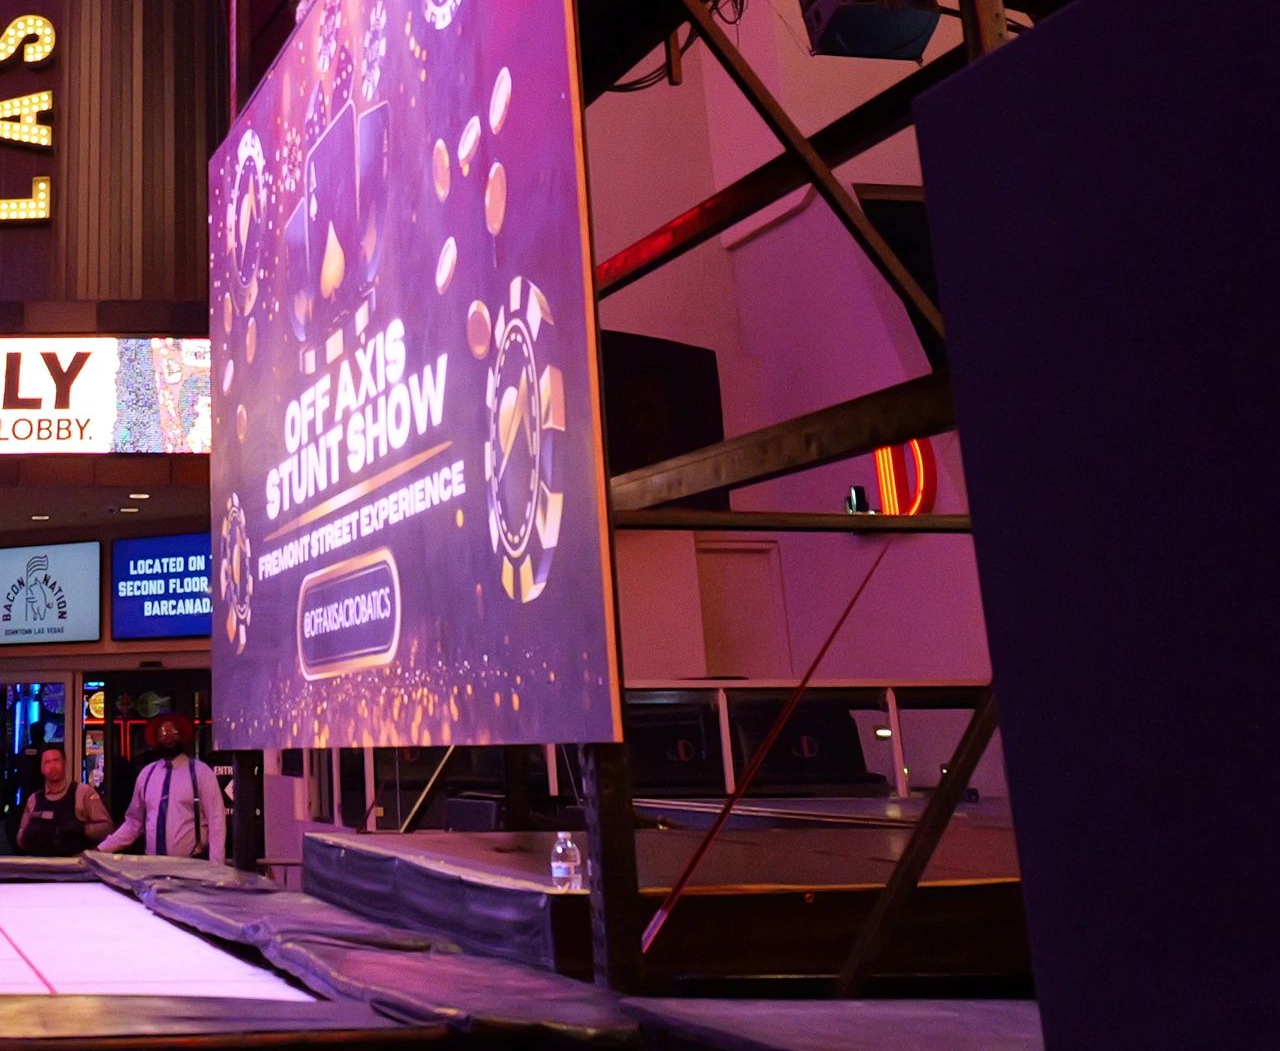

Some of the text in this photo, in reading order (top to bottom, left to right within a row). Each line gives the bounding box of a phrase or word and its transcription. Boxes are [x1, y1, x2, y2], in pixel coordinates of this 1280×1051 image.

[284, 318, 406, 454] OFF AXIS
[265, 352, 449, 520] STUNT SHOW
[258, 459, 467, 581] FREMONT STREET EXPERIENCE
[118, 579, 165, 597] SECOND
[129, 555, 206, 575] LOCATED ON
[1, 573, 68, 622] BACON NATION
[144, 598, 213, 617] BARCANAD
[303, 586, 392, 639] @OFFAXISACROBATICS
[4, 626, 65, 637] DOWNTOWN LAS VEGAS
